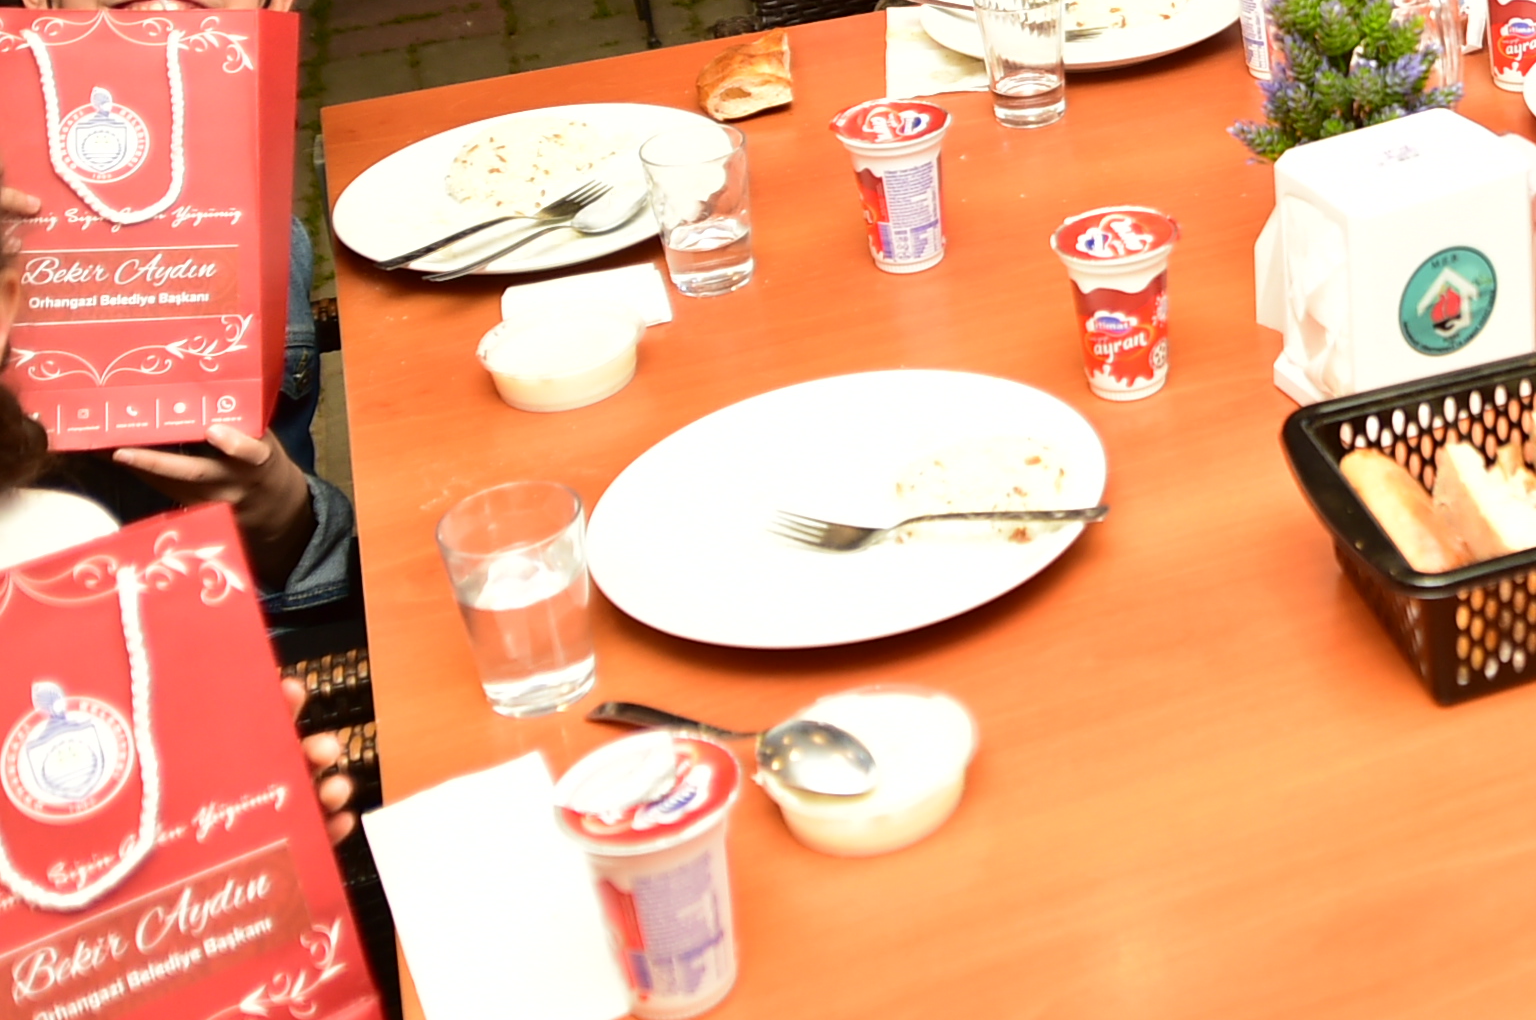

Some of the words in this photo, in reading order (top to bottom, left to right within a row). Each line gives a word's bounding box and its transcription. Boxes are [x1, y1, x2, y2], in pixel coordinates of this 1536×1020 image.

[21, 256, 109, 285] Bekir
[114, 253, 217, 287] Aydın
[28, 294, 97, 310] Orhangazi
[100, 293, 156, 309] Belediye
[158, 291, 210, 306] Başkanı
[1093, 332, 1148, 364] ayran
[11, 931, 129, 1007] Bekir
[135, 874, 272, 953] Aydın
[126, 947, 202, 993] Belediye
[203, 917, 273, 959] Başkanı
